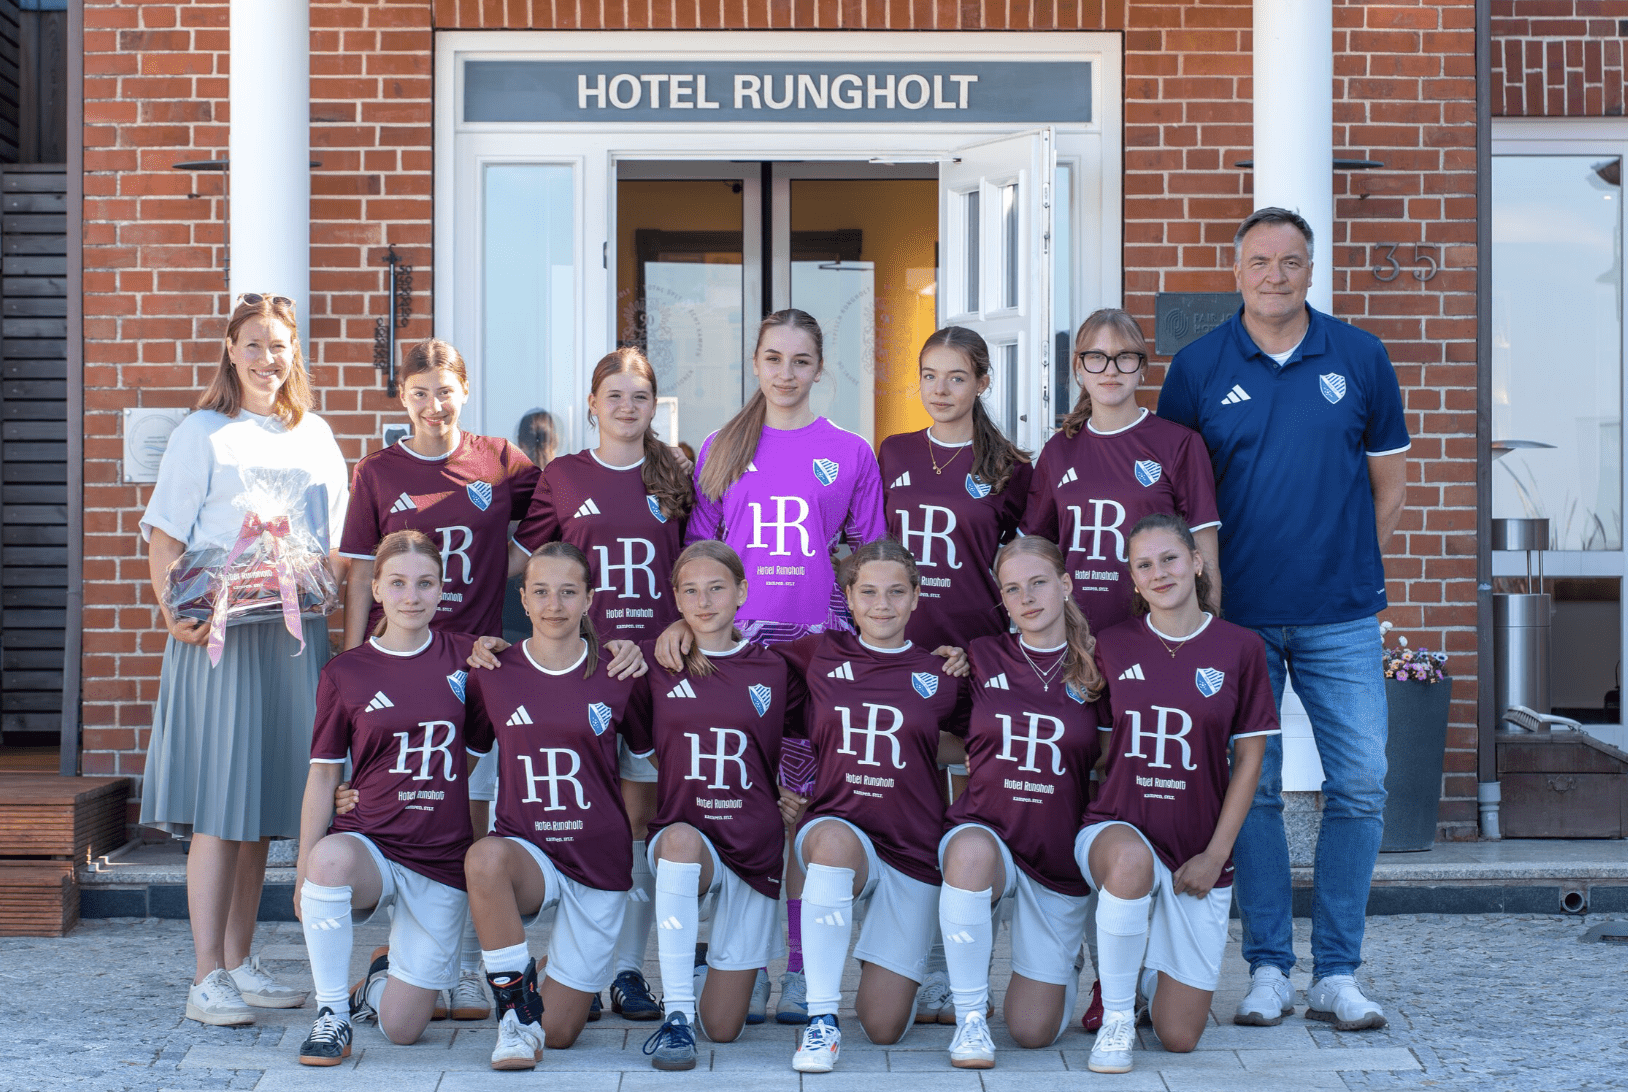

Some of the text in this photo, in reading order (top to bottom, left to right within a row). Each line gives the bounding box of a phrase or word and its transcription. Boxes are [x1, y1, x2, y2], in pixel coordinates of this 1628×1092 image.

[577, 74, 979, 110] HOTEL RUNGHOLT
[1372, 242, 1437, 282] 35
[1220, 313, 1234, 323] JO
[747, 496, 815, 556] HR
[896, 504, 962, 569] HR
[1067, 499, 1128, 562] HR
[592, 537, 661, 599] HR
[606, 608, 653, 618] Hotel Rungholt
[389, 721, 457, 781] HR
[684, 727, 752, 789] HR
[834, 703, 906, 769] HR
[995, 712, 1066, 775] HR
[1124, 705, 1197, 770] HR
[517, 748, 591, 811] HR
[696, 797, 742, 809] Hotel Rungholt
[846, 773, 894, 787] Hotel Rungholt
[1004, 779, 1054, 794] Hotel Rungholt
[1136, 775, 1186, 790] Hotel Rungholt
[553, 820, 583, 831] Rungholt
